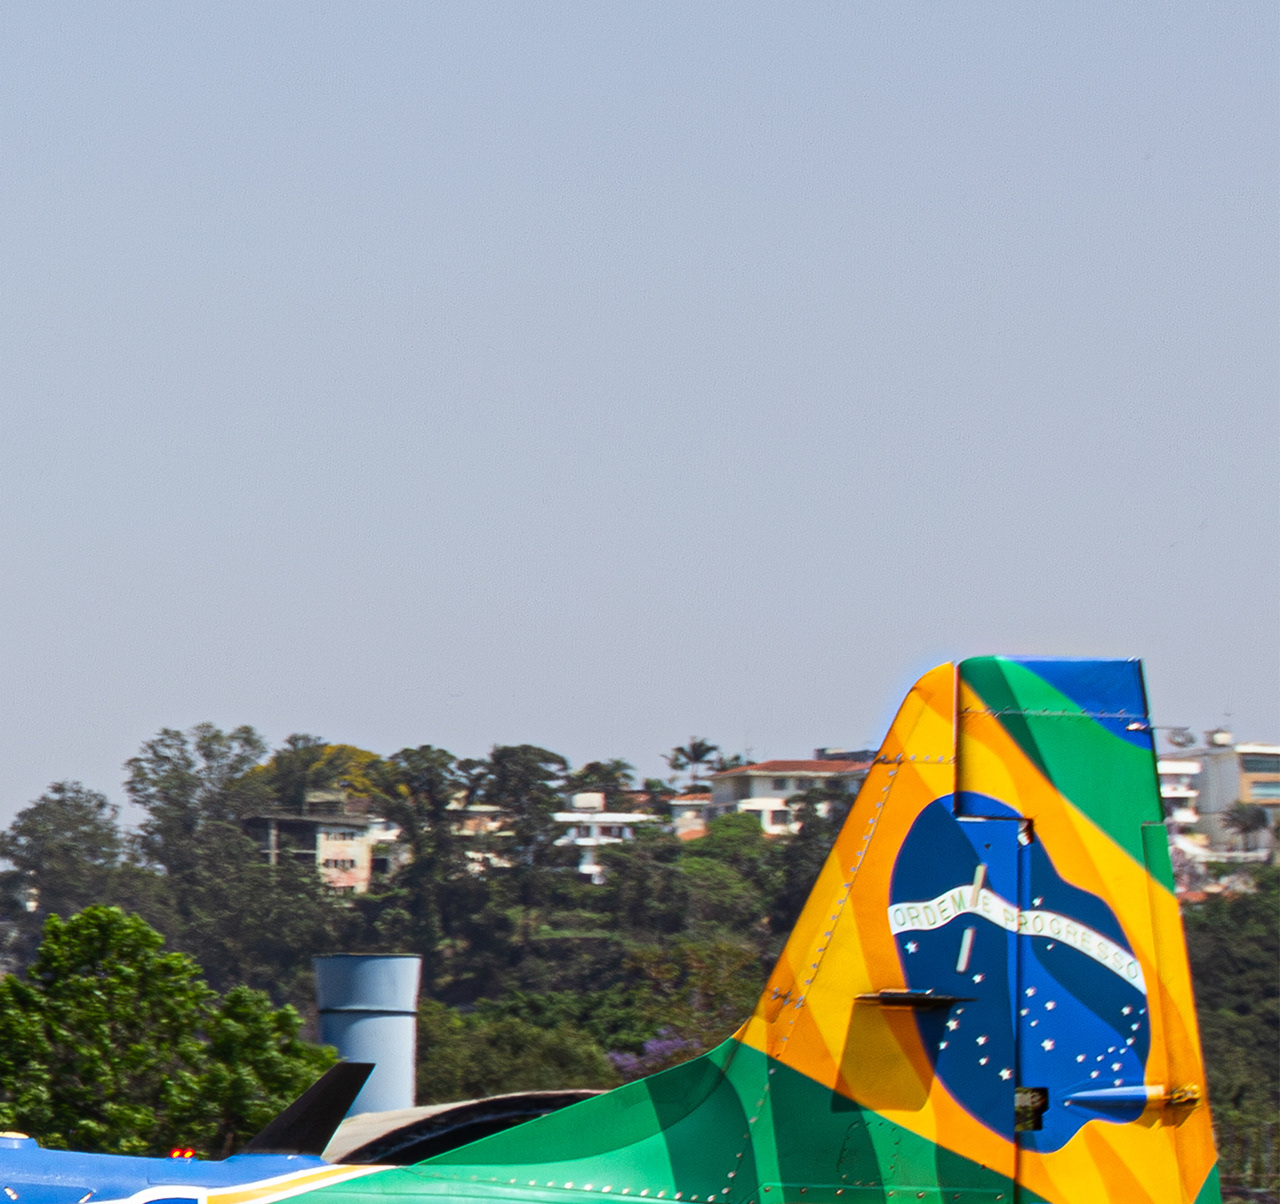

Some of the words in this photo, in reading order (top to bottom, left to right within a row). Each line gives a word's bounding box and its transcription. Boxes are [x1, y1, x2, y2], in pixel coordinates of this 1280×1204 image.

[893, 890, 967, 926] ORDEM
[981, 896, 992, 913] E
[1003, 908, 1139, 980] PROGRESSO
